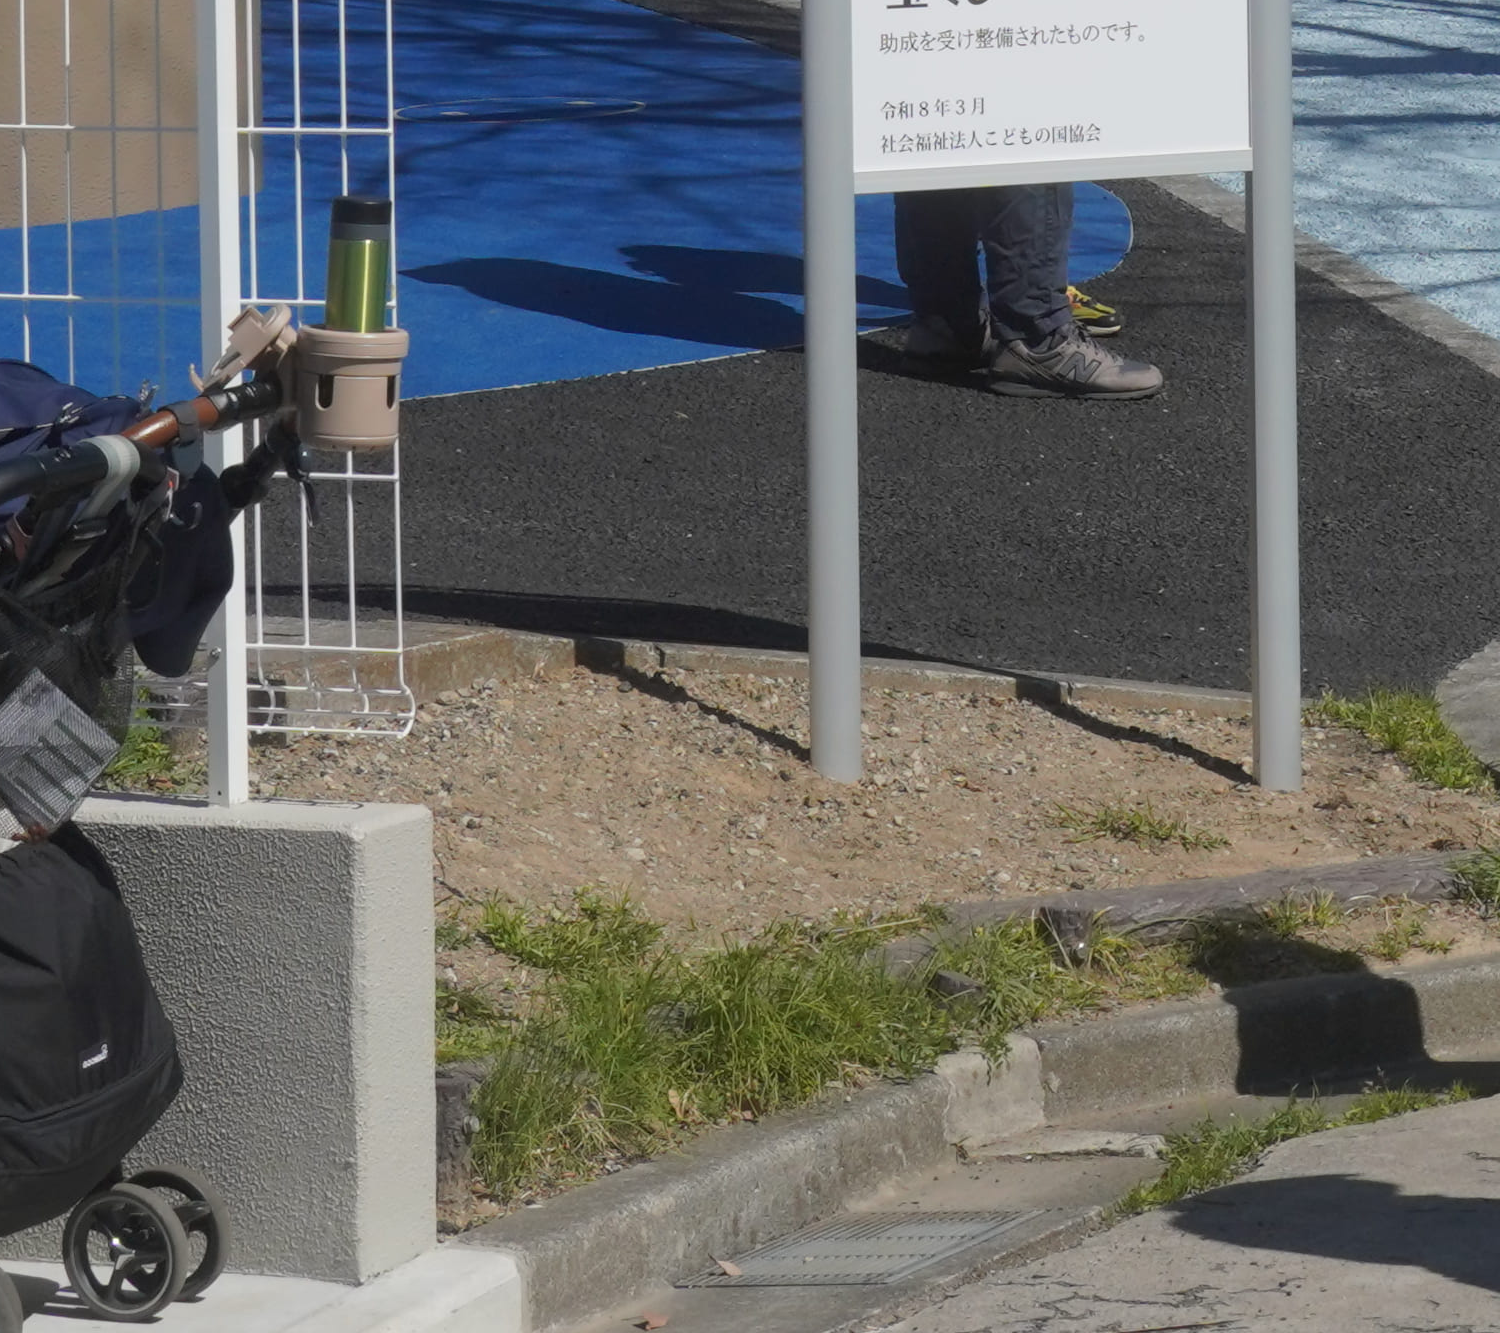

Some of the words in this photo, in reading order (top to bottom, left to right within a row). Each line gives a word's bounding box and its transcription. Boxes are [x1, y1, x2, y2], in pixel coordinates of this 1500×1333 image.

[879, 21, 1146, 55] 助成を受け整備されたものです。
[880, 122, 1102, 154] 社会福祉法人こどもの国協会
